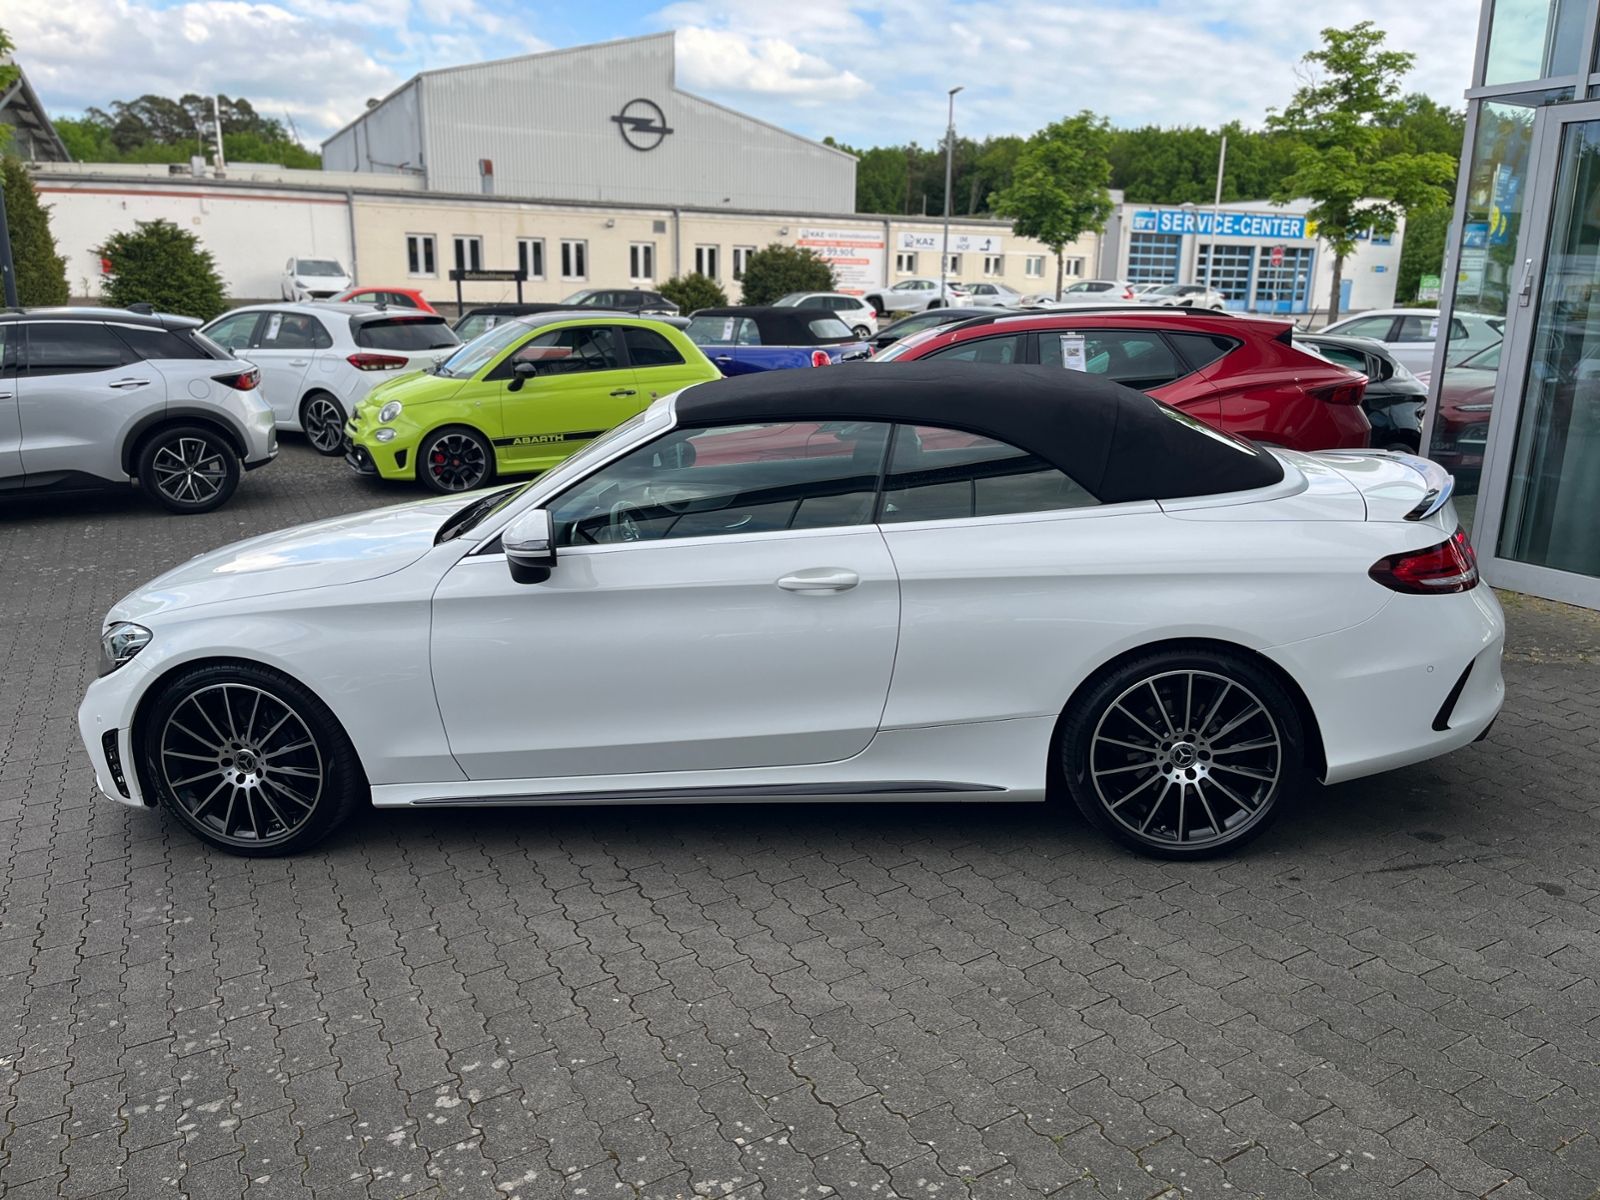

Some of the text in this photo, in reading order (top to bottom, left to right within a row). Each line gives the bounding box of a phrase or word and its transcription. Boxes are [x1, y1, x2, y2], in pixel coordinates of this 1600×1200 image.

[1160, 213, 1301, 237] SERVICE-CENTER
[915, 237, 936, 246] KAZ
[512, 433, 565, 446] ABARTH
